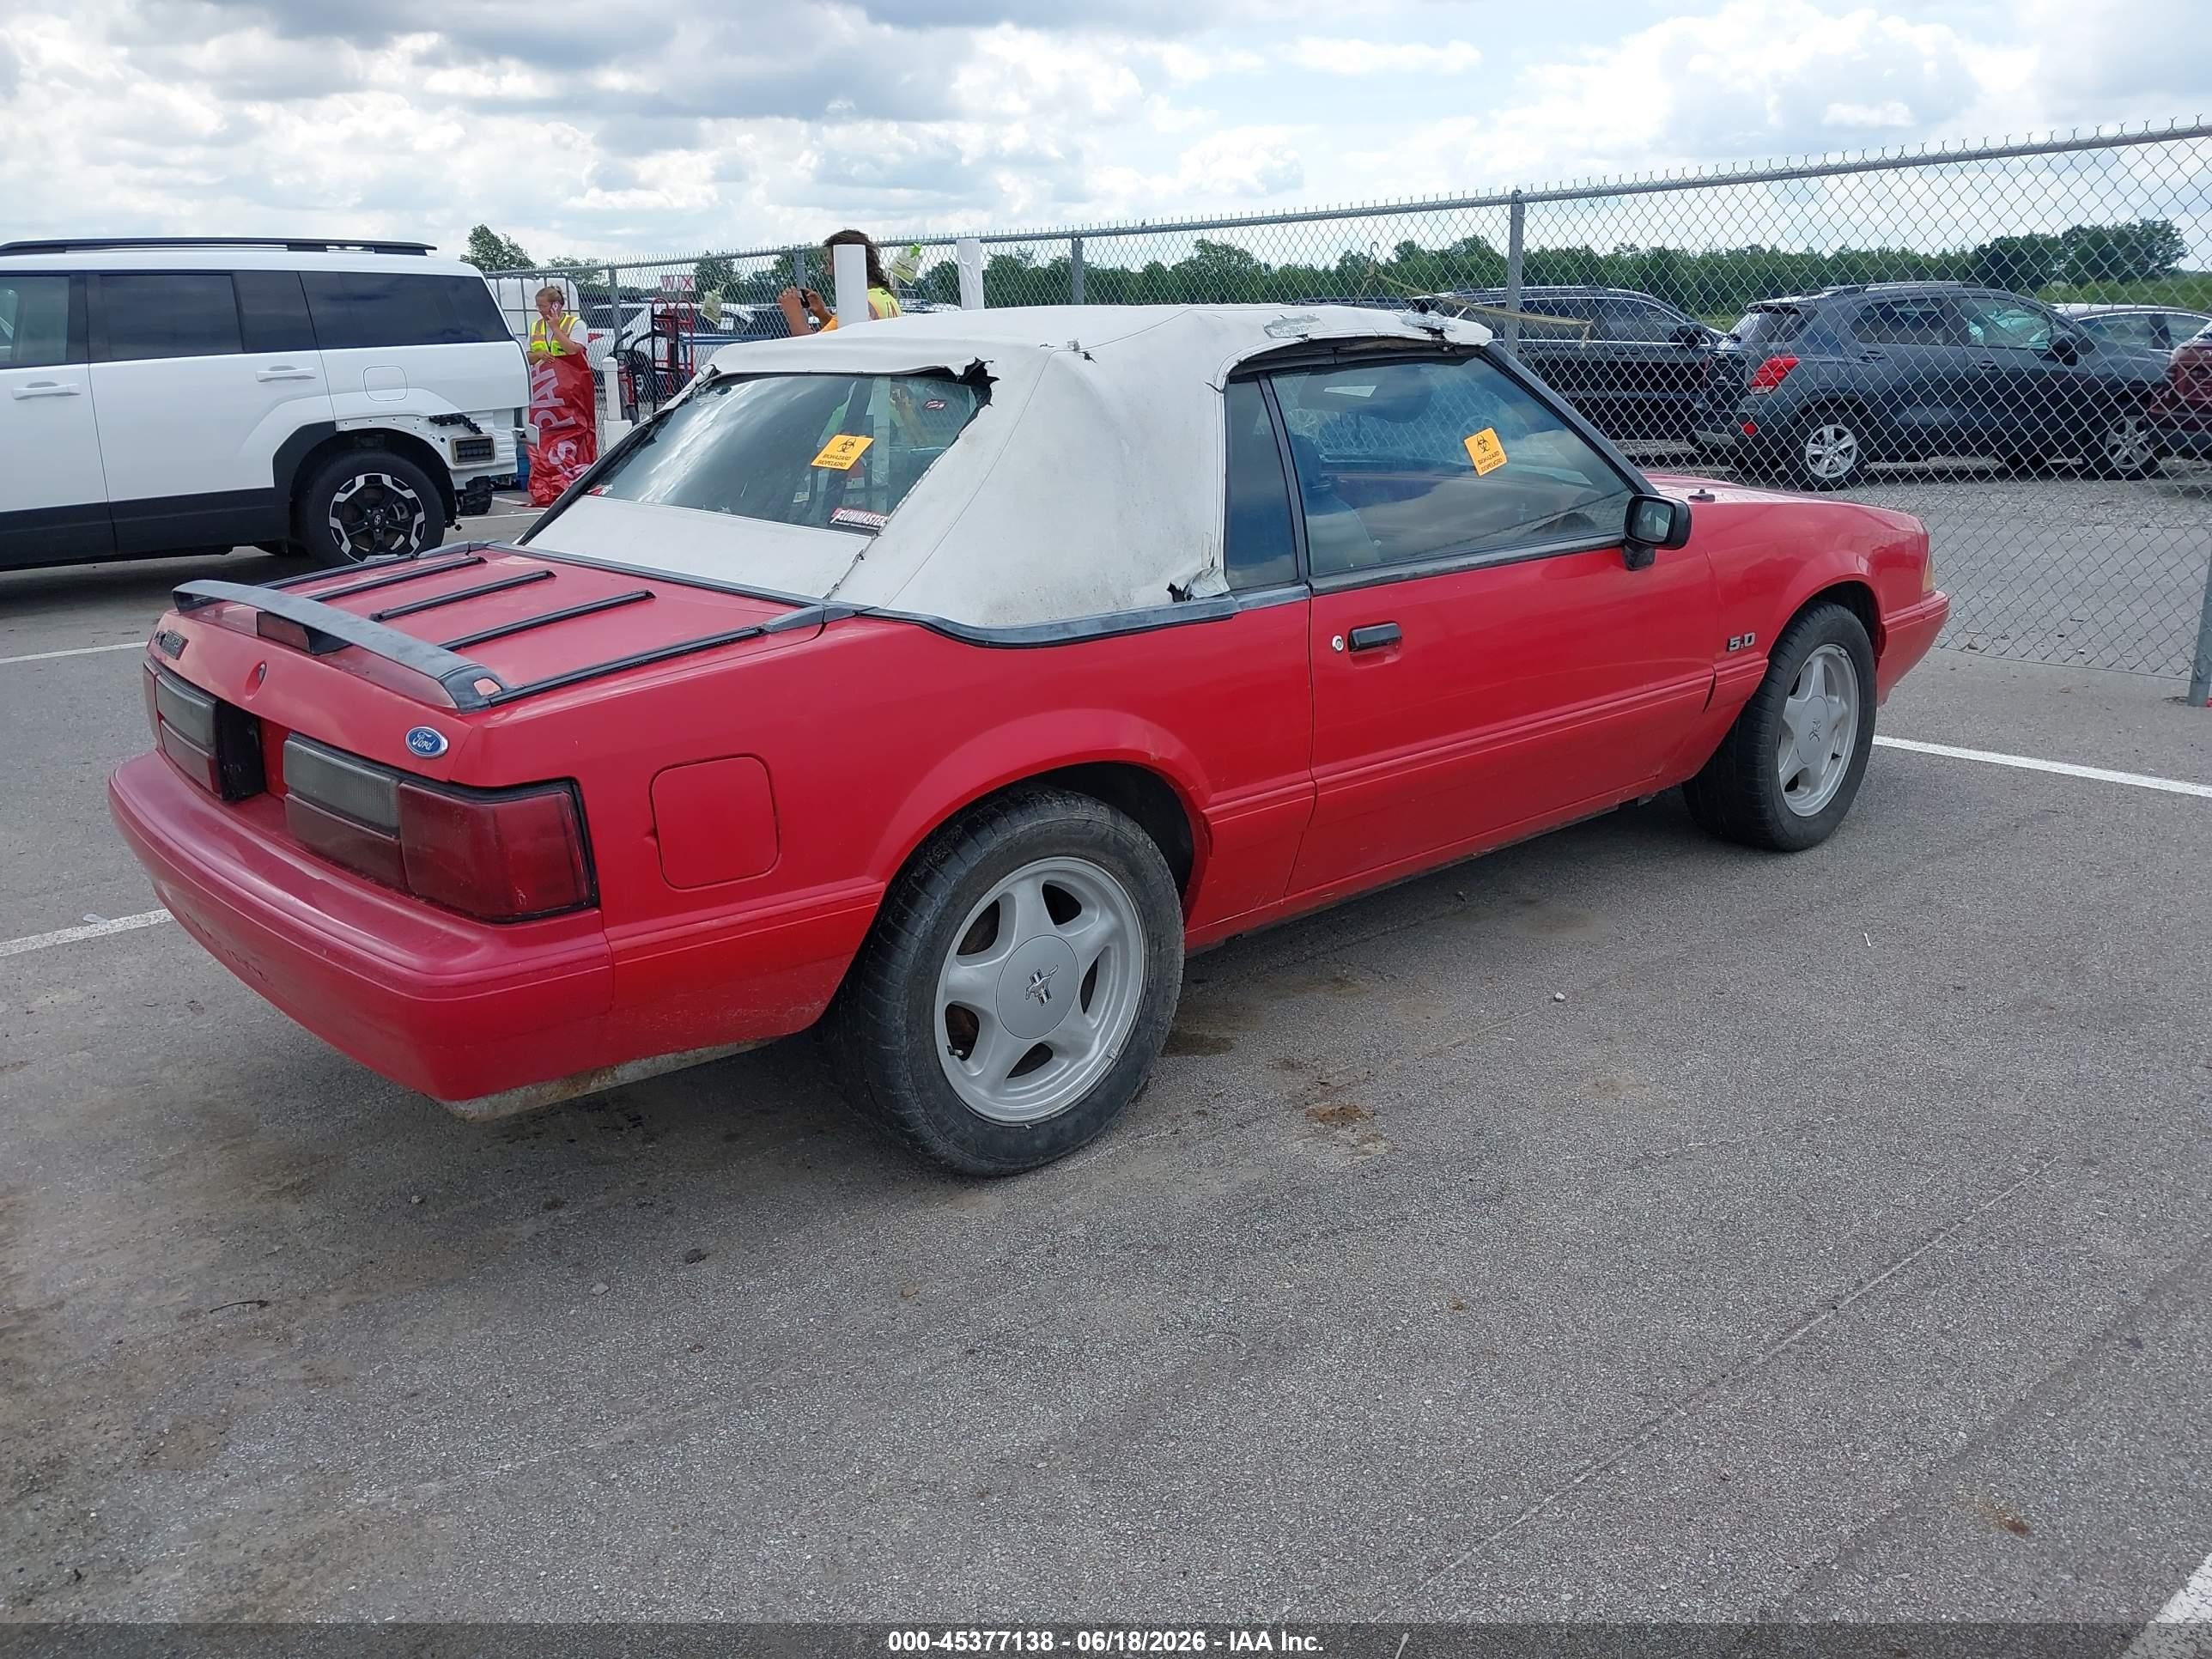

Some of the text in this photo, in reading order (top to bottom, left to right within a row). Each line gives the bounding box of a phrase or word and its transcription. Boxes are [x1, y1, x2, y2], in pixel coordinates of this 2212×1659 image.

[830, 508, 889, 527] FLOWMASTER
[1728, 632, 1756, 652] 5.0
[412, 731, 436, 750] Ford
